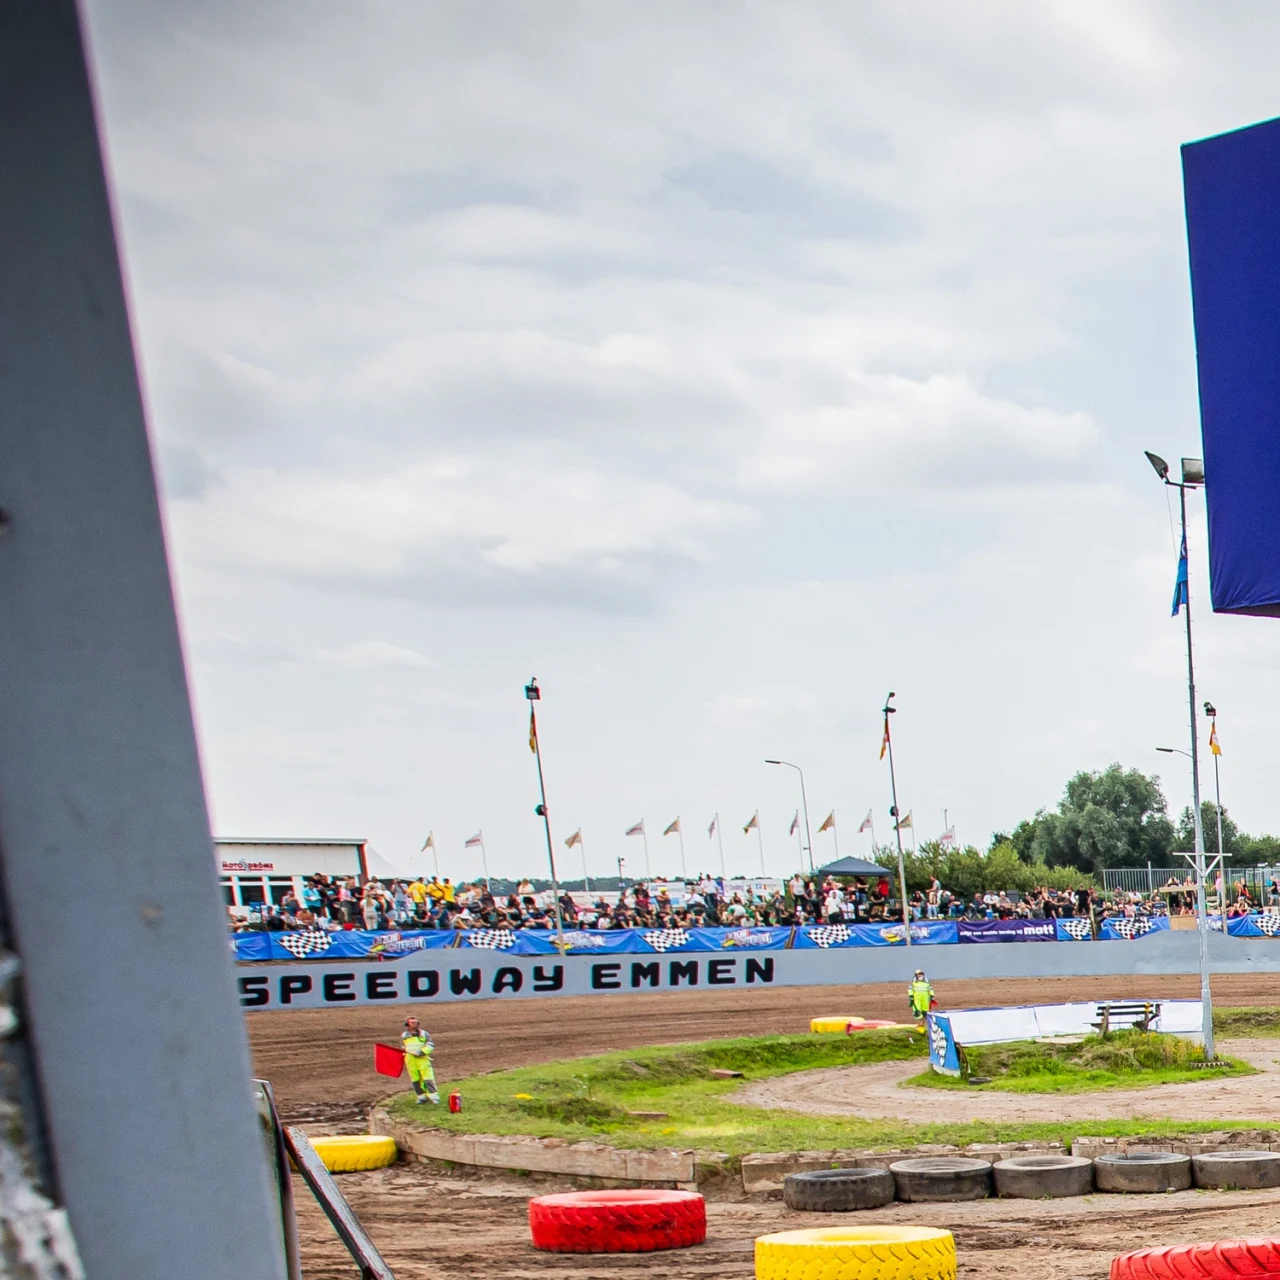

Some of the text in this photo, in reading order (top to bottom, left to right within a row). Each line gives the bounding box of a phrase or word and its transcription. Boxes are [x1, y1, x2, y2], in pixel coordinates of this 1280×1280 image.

[1023, 925, 1054, 935] matt
[240, 957, 775, 1006] SPEEDWAY EMMEN
